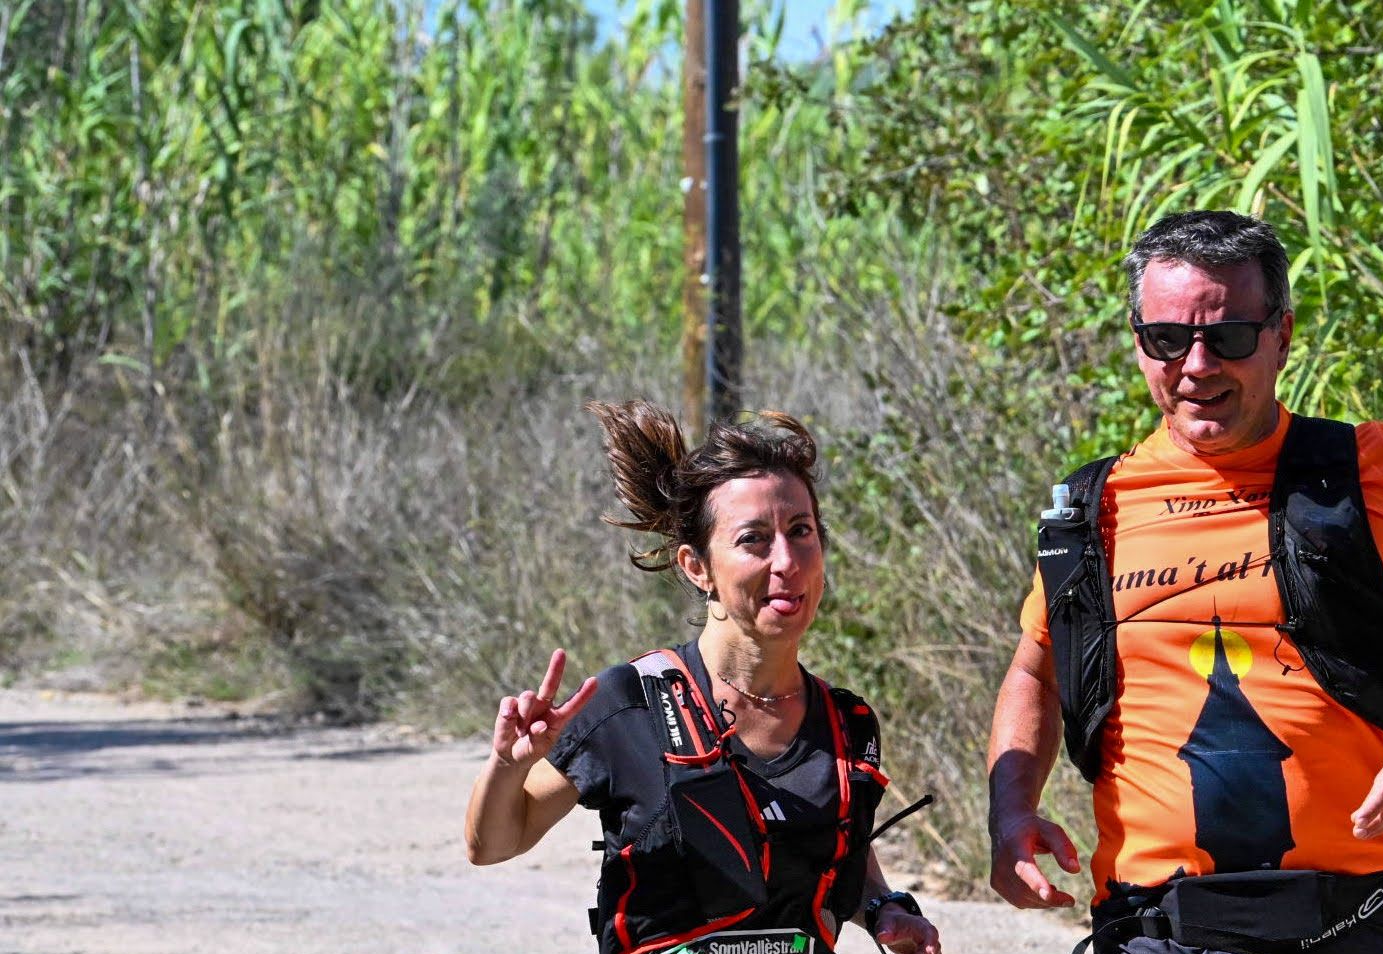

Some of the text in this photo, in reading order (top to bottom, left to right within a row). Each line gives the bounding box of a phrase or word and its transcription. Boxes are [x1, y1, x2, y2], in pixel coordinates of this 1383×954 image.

[1159, 496, 1217, 516] Xino
[1217, 551, 1253, 582] al
[660, 691, 683, 747] AONIJIE
[1301, 914, 1357, 950] kalenji
